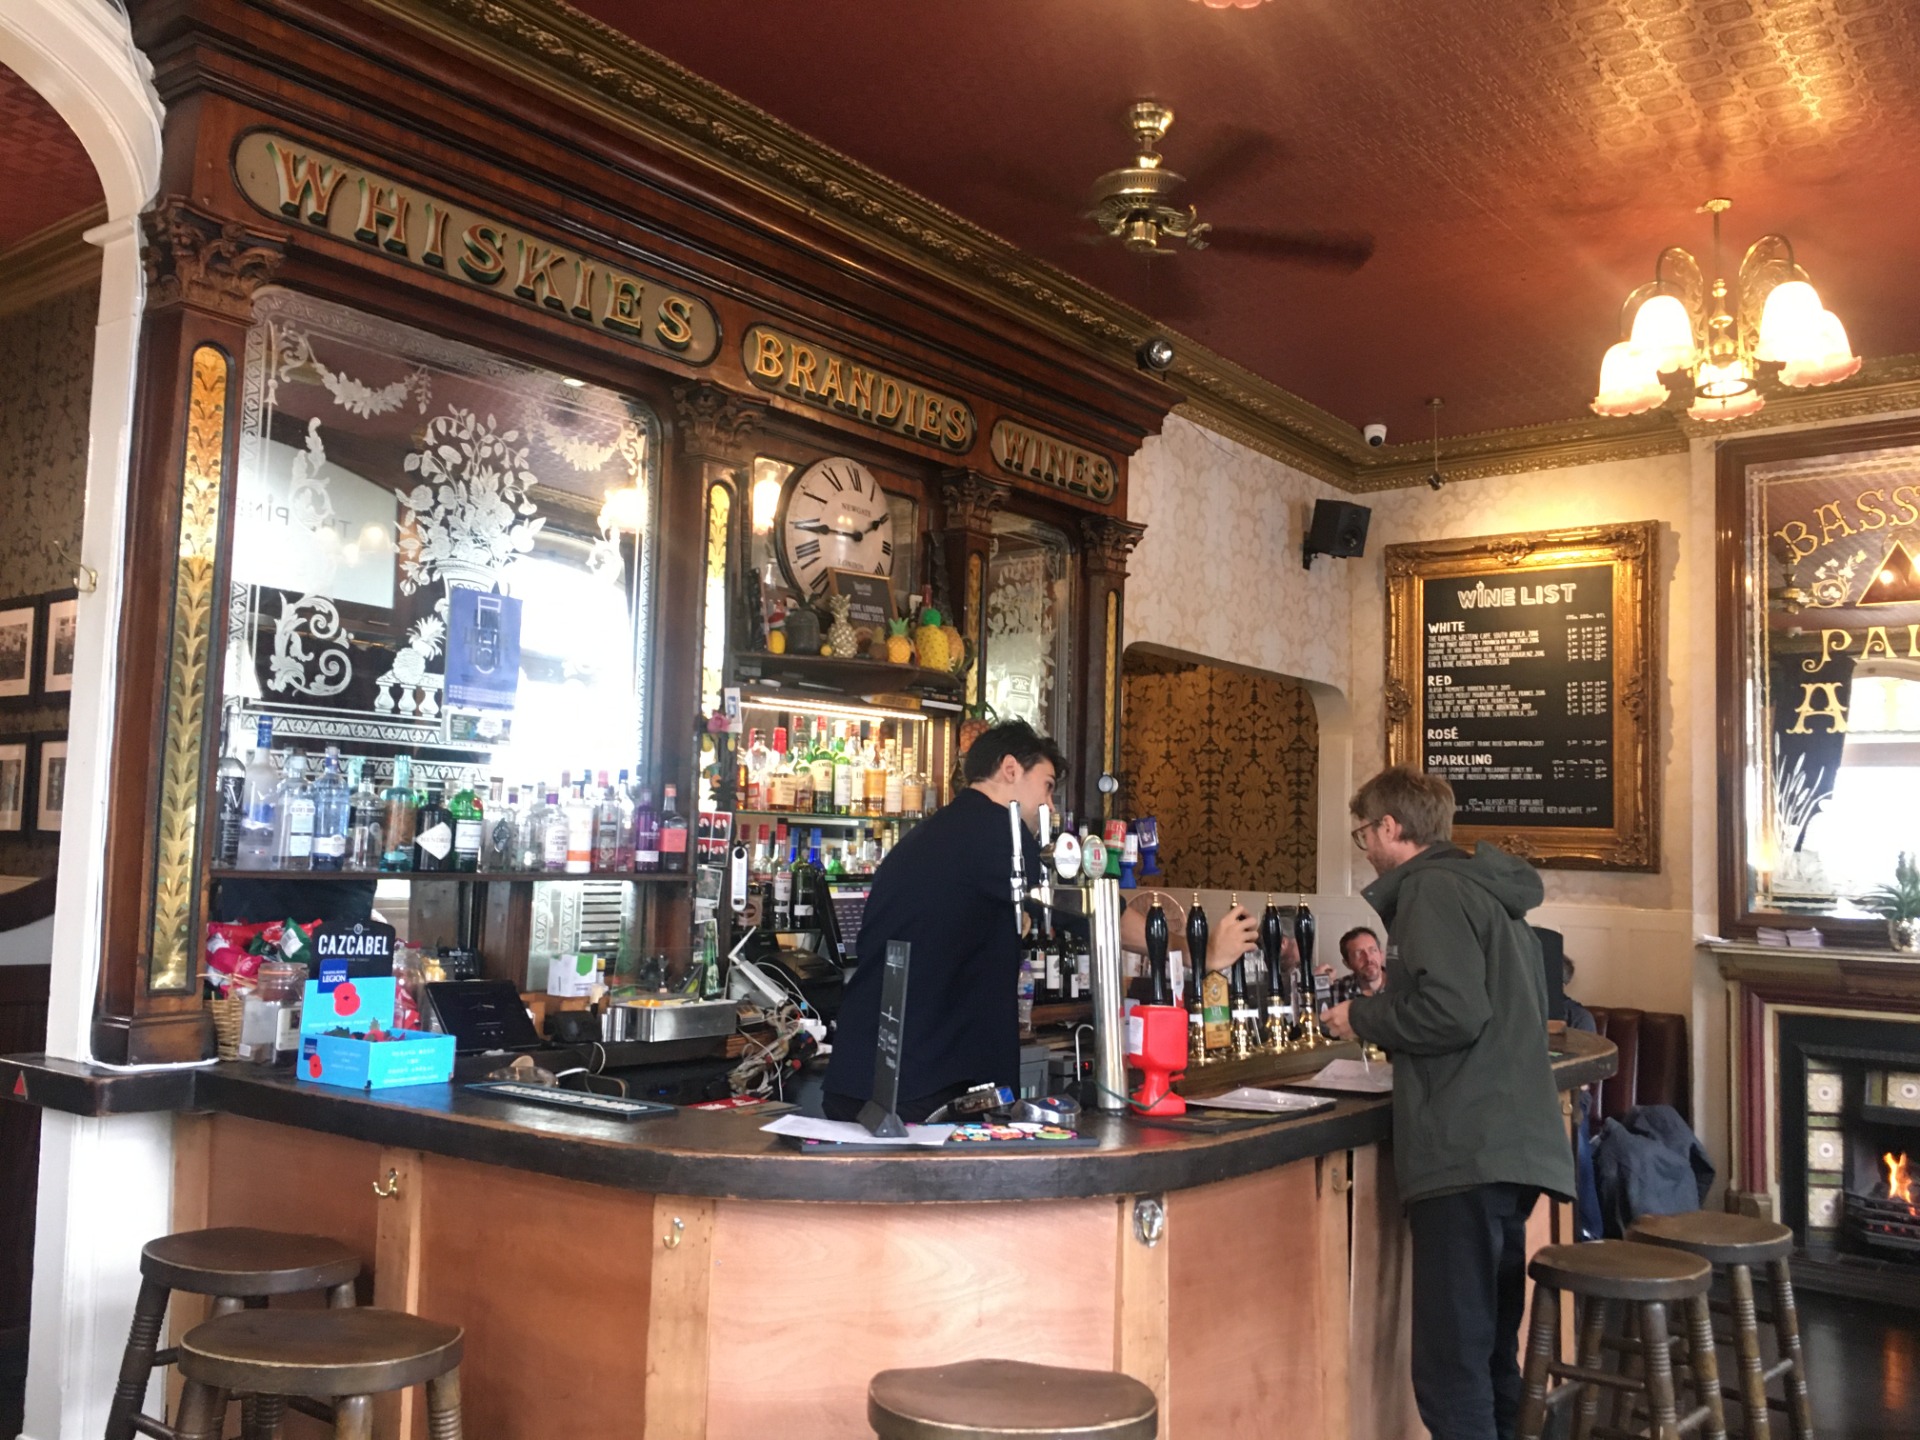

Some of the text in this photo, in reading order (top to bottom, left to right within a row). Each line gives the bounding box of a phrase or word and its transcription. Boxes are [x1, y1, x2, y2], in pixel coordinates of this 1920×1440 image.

[265, 141, 695, 352] WHISKIES
[753, 329, 968, 450] BRANDIES
[1001, 423, 1111, 499] WINES
[840, 502, 872, 518] NEWGATE
[837, 557, 865, 571] LONDON
[1520, 582, 1577, 606] LIST
[1427, 621, 1466, 634] WHITE
[1427, 675, 1453, 686] RED
[1427, 728, 1459, 740] ROSÉ
[1427, 754, 1493, 767] SPARKLING
[317, 934, 390, 956] CAZCABEL
[321, 974, 347, 984] LEGION
